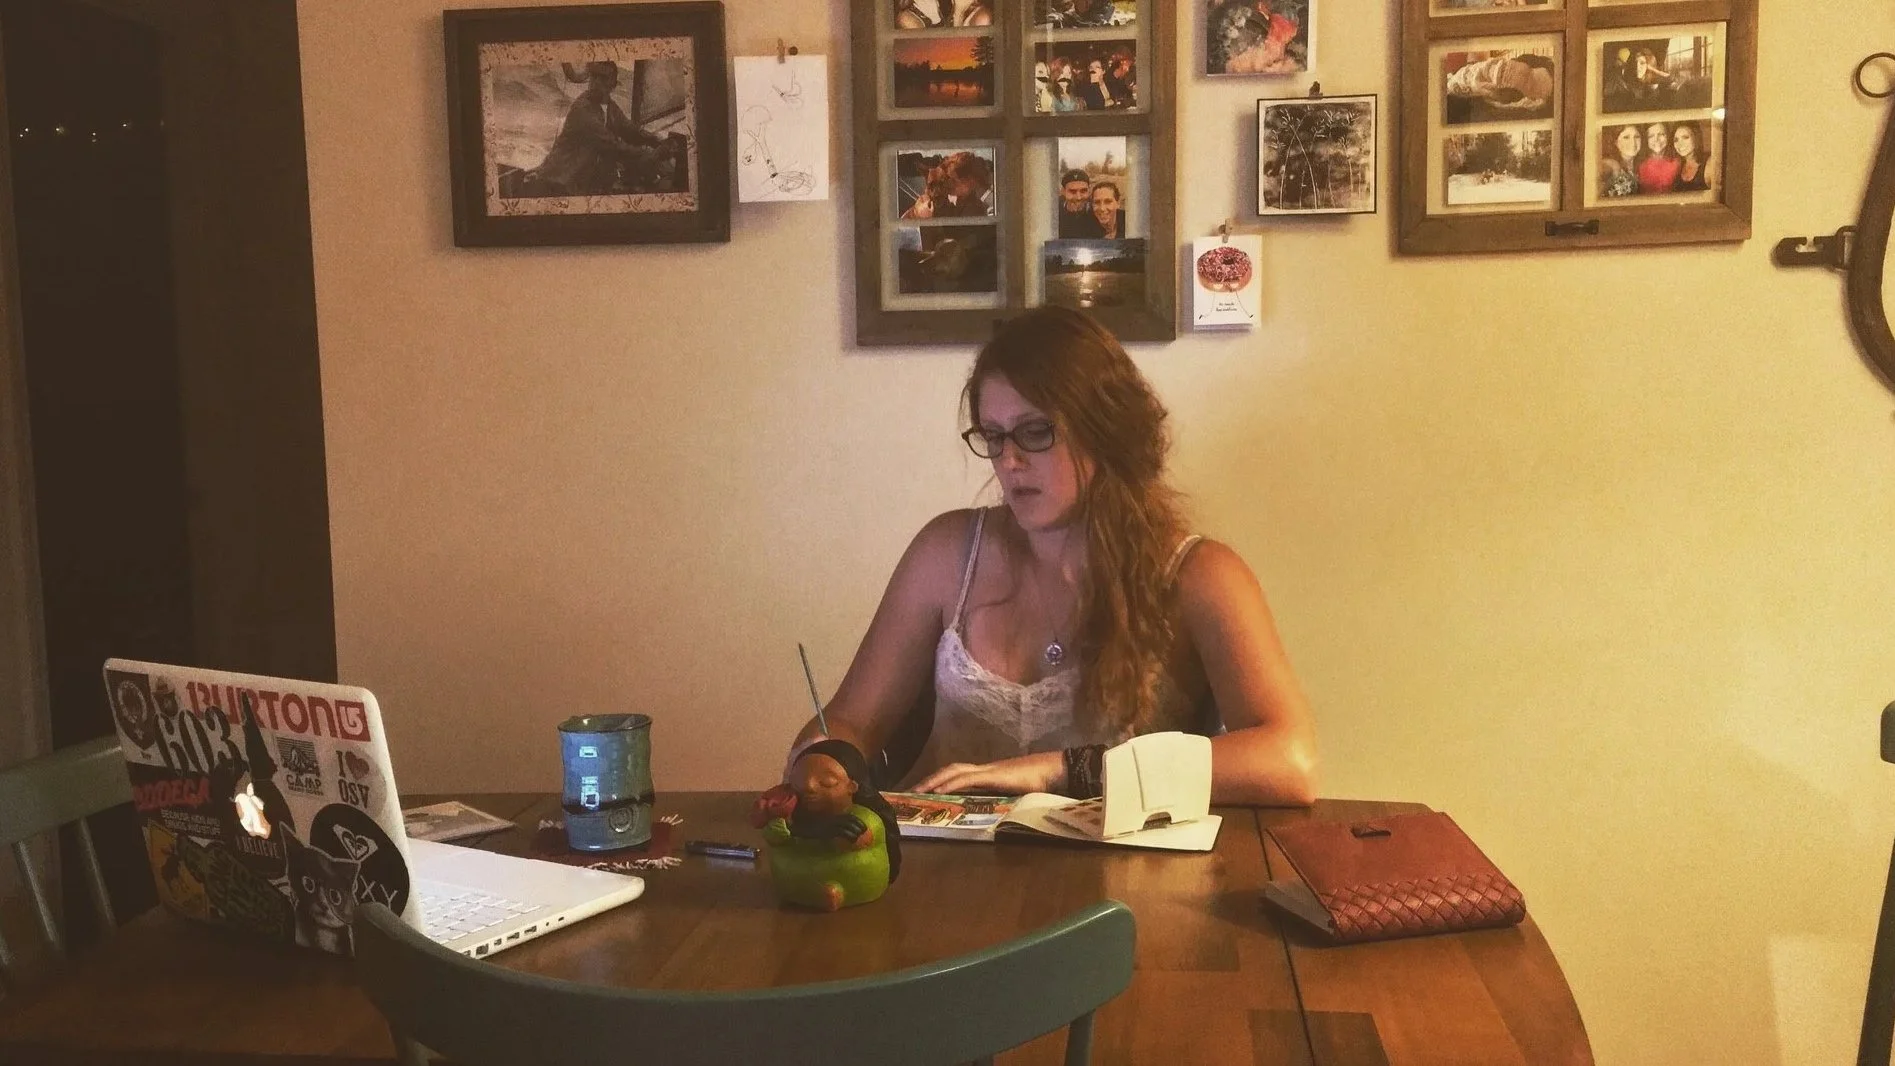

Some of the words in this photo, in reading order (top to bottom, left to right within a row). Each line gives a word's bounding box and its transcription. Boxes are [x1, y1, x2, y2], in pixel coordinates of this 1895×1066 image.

[186, 681, 338, 738] BURTON
[153, 706, 242, 775] 603
[286, 774, 322, 789] CAMP
[336, 750, 346, 777] I
